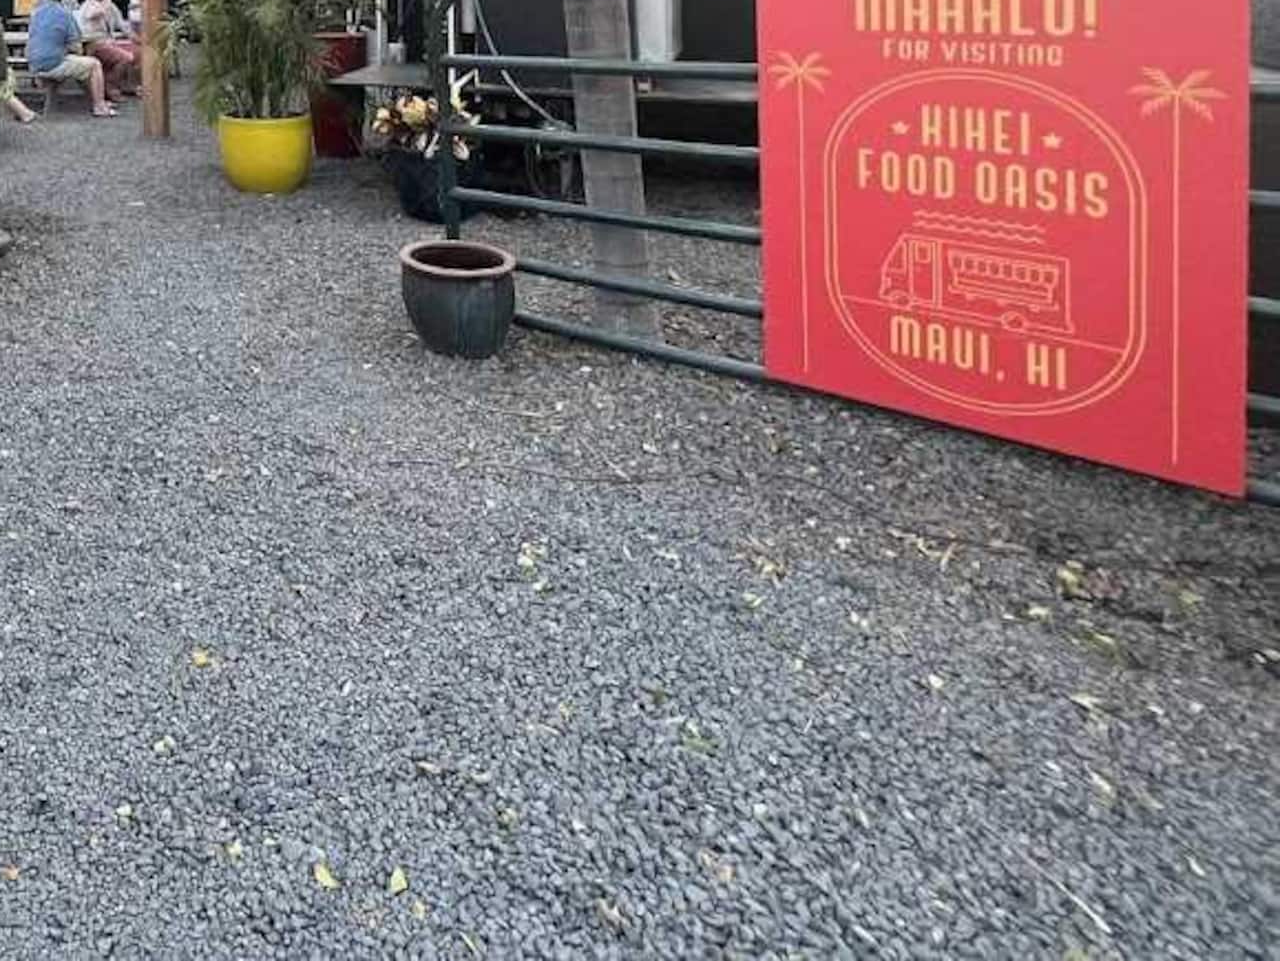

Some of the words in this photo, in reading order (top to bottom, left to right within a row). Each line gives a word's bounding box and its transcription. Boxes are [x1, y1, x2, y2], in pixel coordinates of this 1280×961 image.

[883, 38, 930, 61] FOR
[941, 41, 1064, 67] VISITING
[858, 147, 955, 200] FOOD
[976, 160, 1109, 219] OASIS
[1028, 342, 1066, 390] HI
